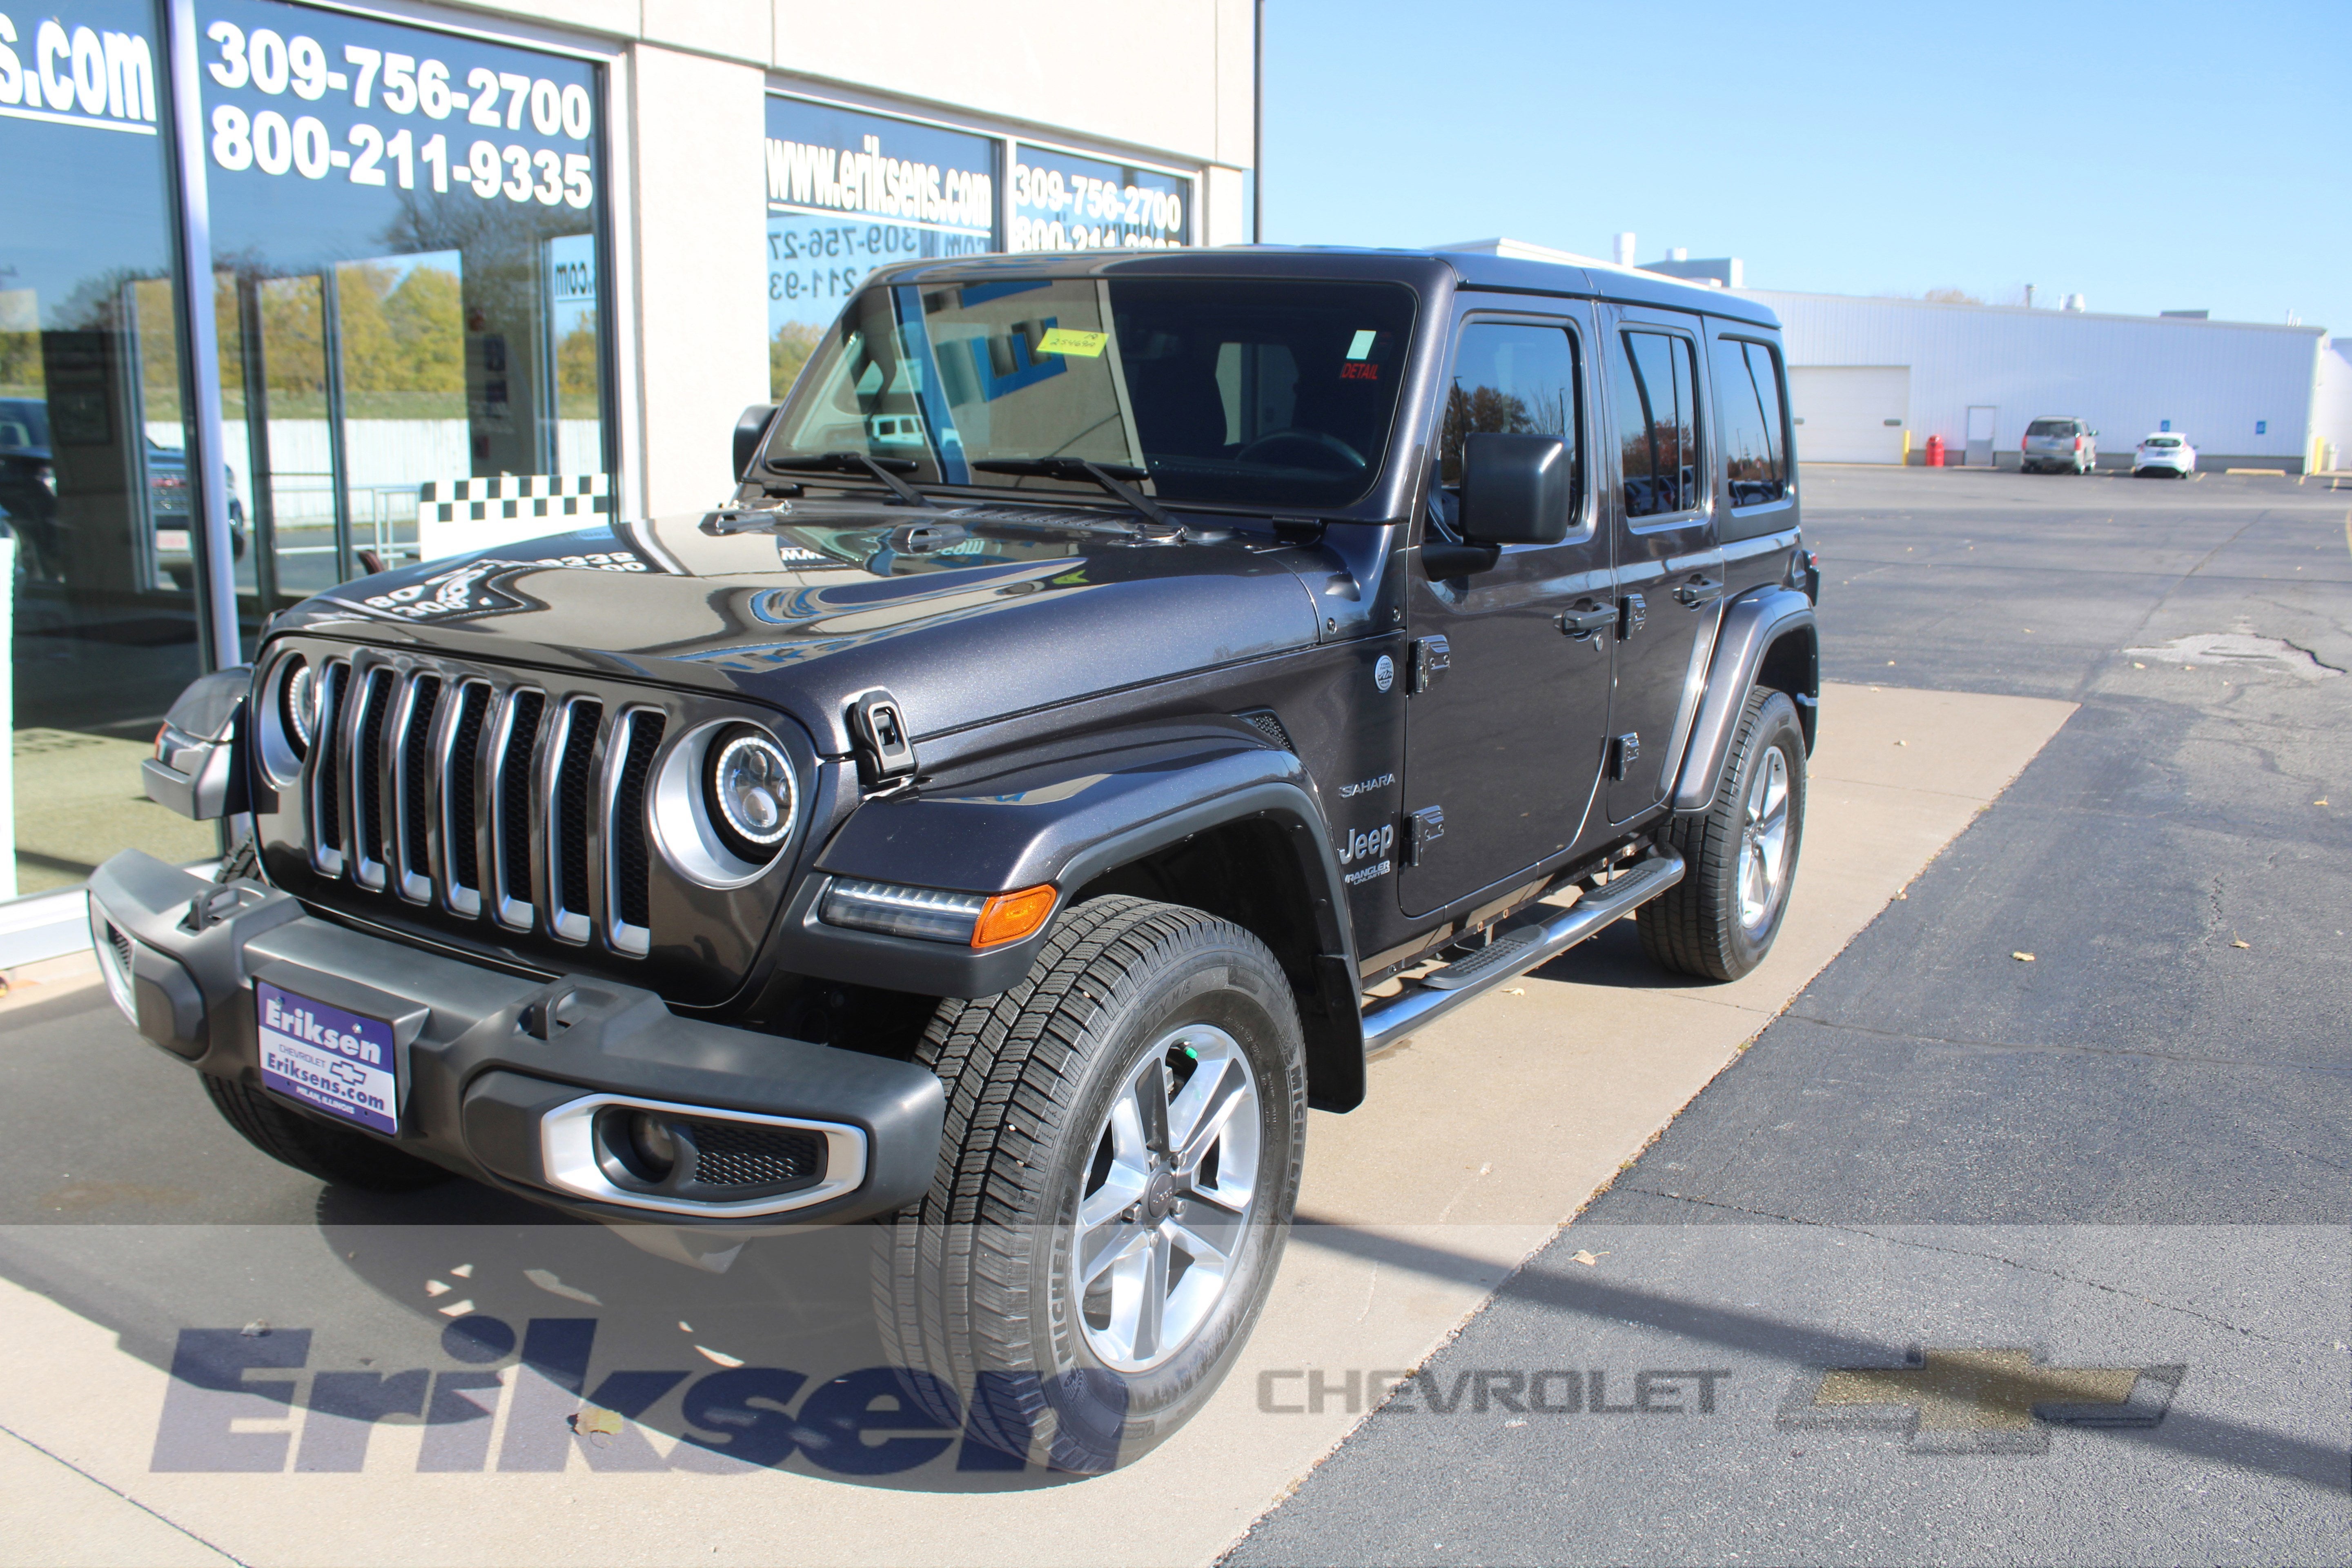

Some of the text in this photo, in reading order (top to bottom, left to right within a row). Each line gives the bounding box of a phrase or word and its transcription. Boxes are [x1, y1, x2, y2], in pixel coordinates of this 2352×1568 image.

[207, 21, 592, 140] 309-756-2700
[212, 104, 593, 209] 800-211-9335
[765, 134, 992, 229] www.eriksens.com
[1015, 164, 1181, 233] 309-756-2700
[1341, 363, 1379, 380] DETAIL
[1339, 773, 1396, 798] SAHARA
[1339, 824, 1394, 865] Jeep
[265, 998, 381, 1065] Eriksen
[267, 1052, 385, 1111] Eriksens.com
[1052, 1184, 1075, 1364] MICHELIN
